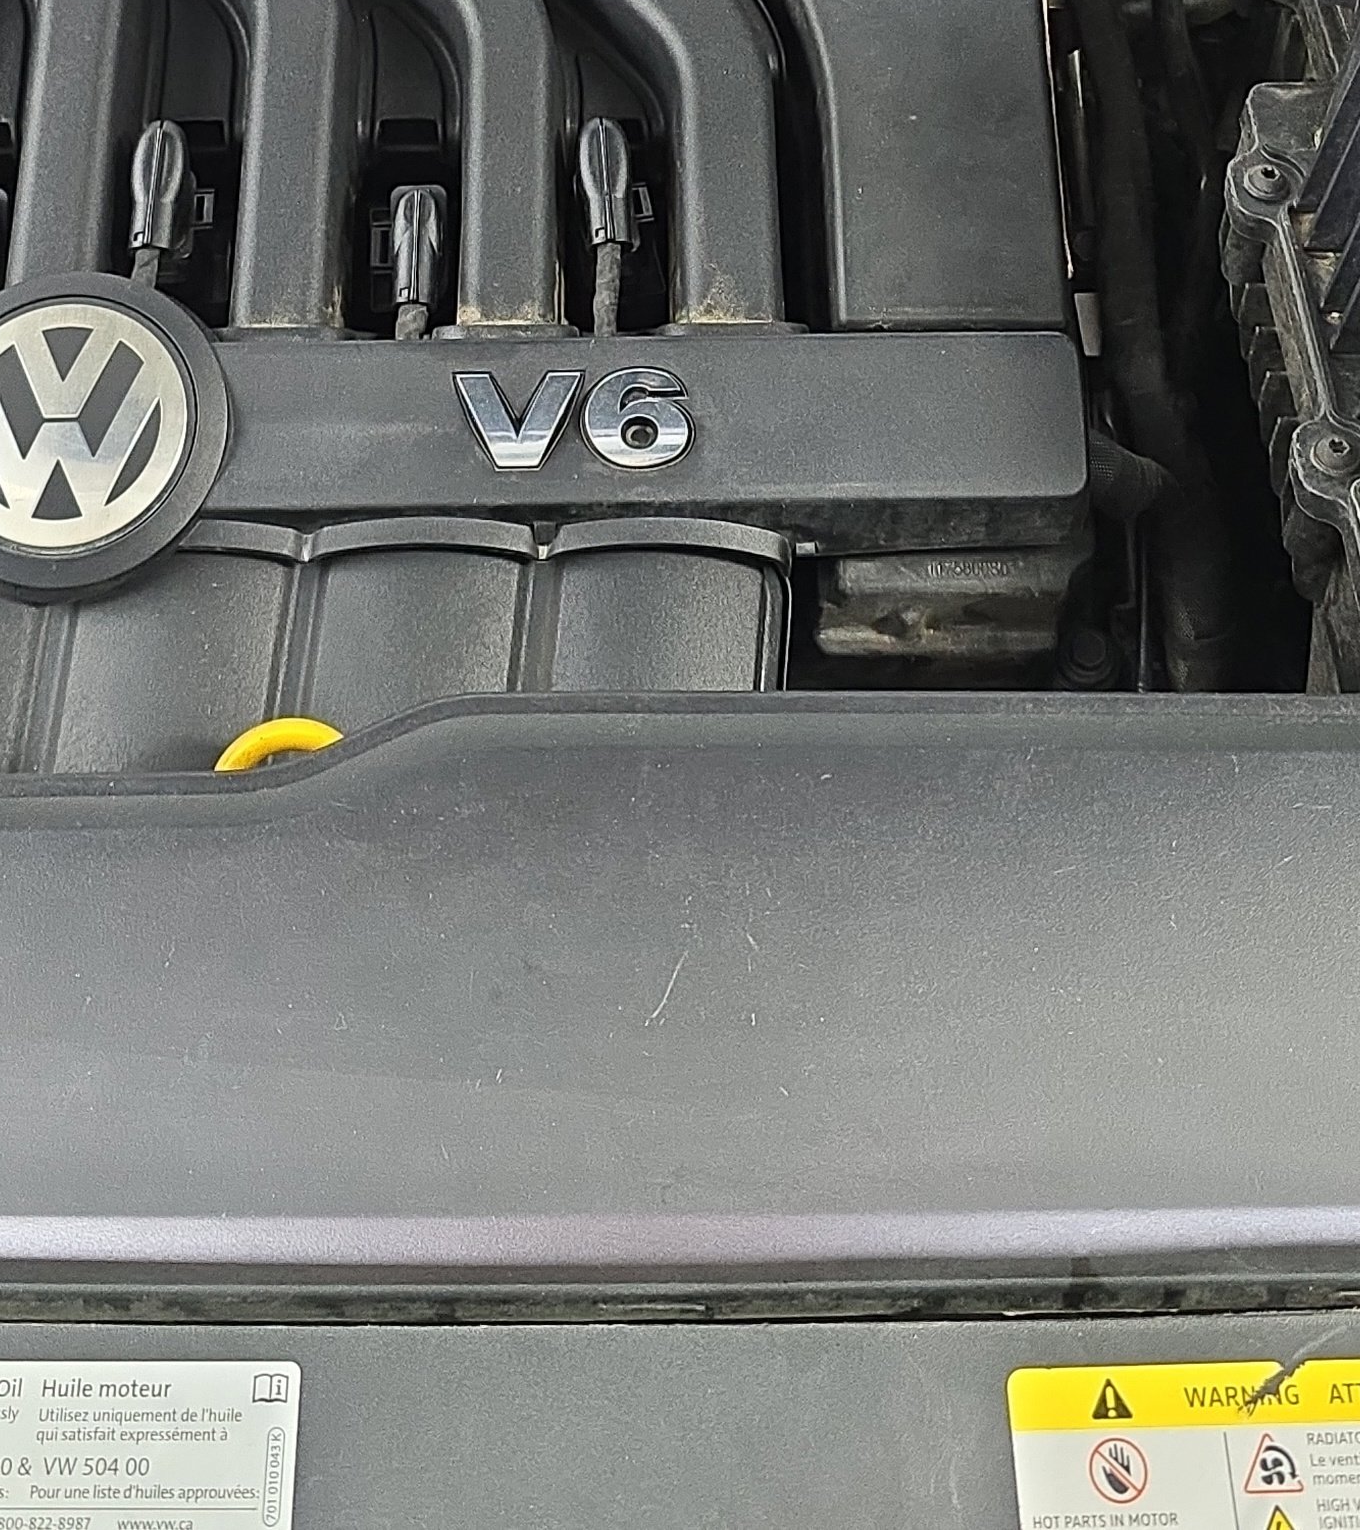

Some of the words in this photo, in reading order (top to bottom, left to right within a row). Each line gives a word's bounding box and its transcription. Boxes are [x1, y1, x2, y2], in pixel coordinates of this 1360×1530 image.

[453, 365, 697, 472] V6
[42, 1378, 92, 1397] Huile
[99, 1380, 171, 1397] moteur
[39, 1408, 88, 1422] Utilisez
[92, 1408, 177, 1426] uniquement
[181, 1408, 197, 1422] de
[202, 1408, 242, 1422] l'huile
[37, 1428, 58, 1445] qui
[61, 1427, 116, 1441] satisfait
[120, 1428, 216, 1445] expressément
[220, 1428, 228, 1441] à
[272, 1432, 282, 1442] K
[270, 1444, 281, 1469] 043
[1310, 1454, 1325, 1467] Le
[18, 1457, 32, 1476] &
[43, 1457, 78, 1476] VW
[82, 1457, 119, 1476] 504
[125, 1457, 150, 1476] 00
[30, 1485, 61, 1500] Pour
[64, 1488, 89, 1499] une
[93, 1485, 120, 1499] liste
[124, 1484, 175, 1499] d'huiles
[178, 1485, 259, 1503] approuvées:
[268, 1473, 279, 1498] 010
[266, 1499, 277, 1520] 701
[1316, 1498, 1349, 1512] HIGH
[117, 1519, 193, 1530] www.vw.ca
[1033, 1515, 1060, 1529] HOT
[1065, 1514, 1106, 1528] PARTS
[1111, 1514, 1124, 1527] IN
[1128, 1512, 1179, 1526] MOTOR
